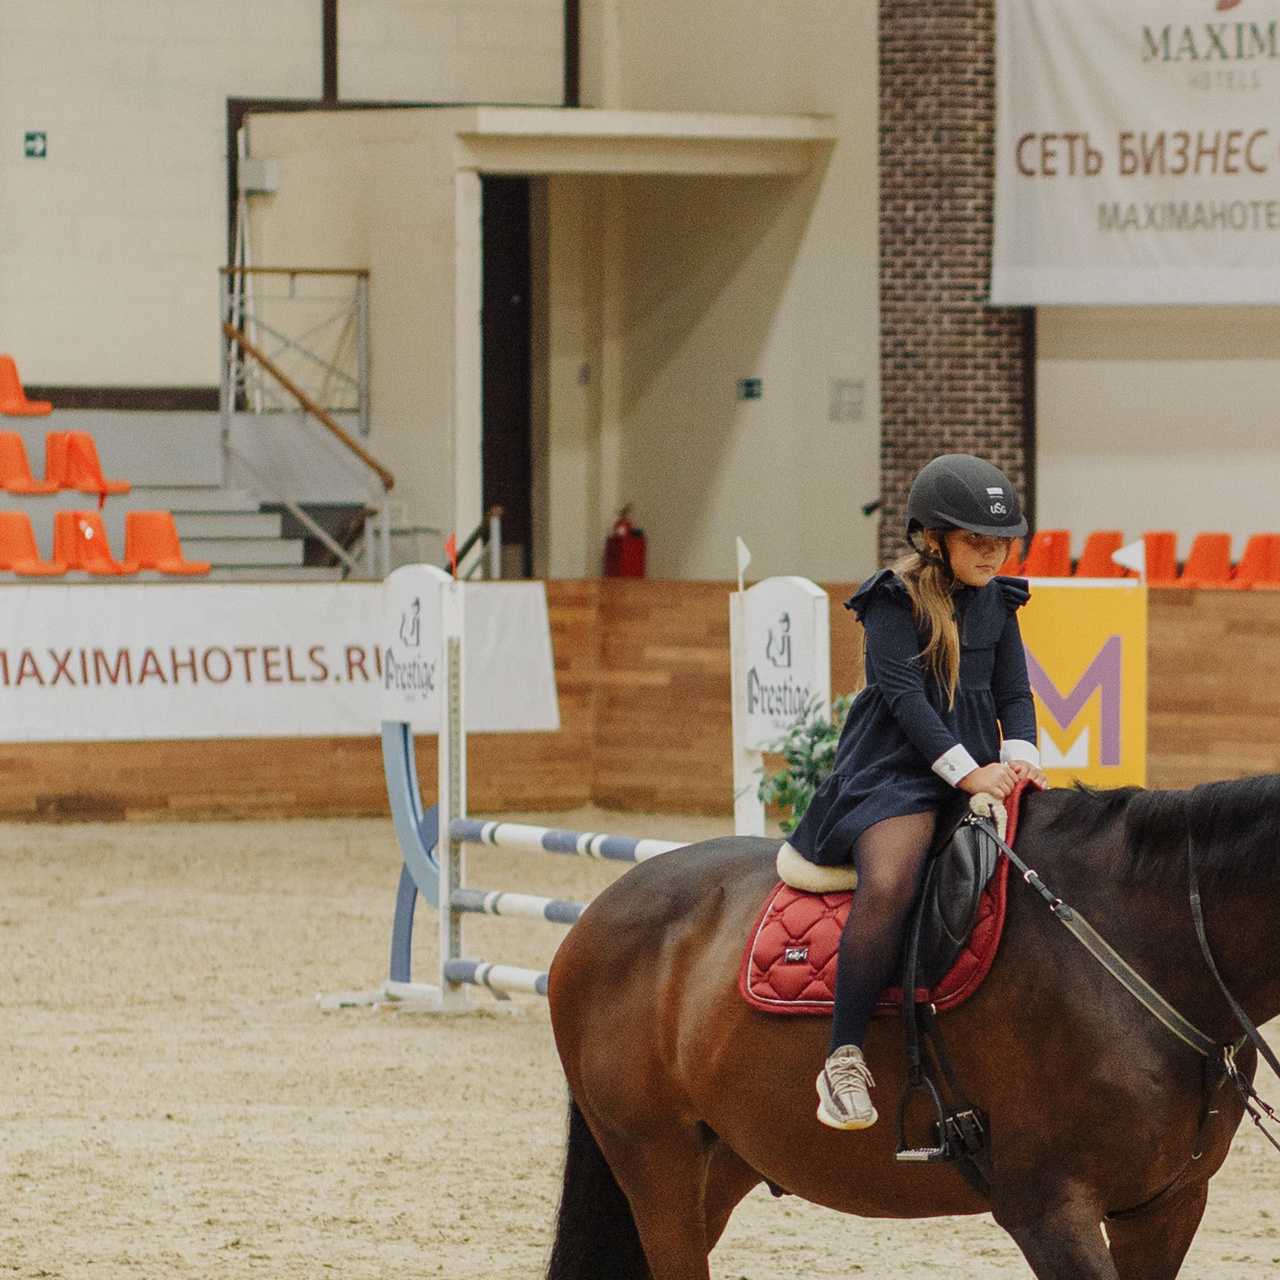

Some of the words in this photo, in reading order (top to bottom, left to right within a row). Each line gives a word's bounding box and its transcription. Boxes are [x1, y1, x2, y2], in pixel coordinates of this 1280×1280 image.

[1015, 133, 1103, 177] СЕТЬ
[1118, 129, 1268, 176] БИЗНЕС
[990, 502, 1007, 515] USG
[384, 646, 438, 699] Prestige
